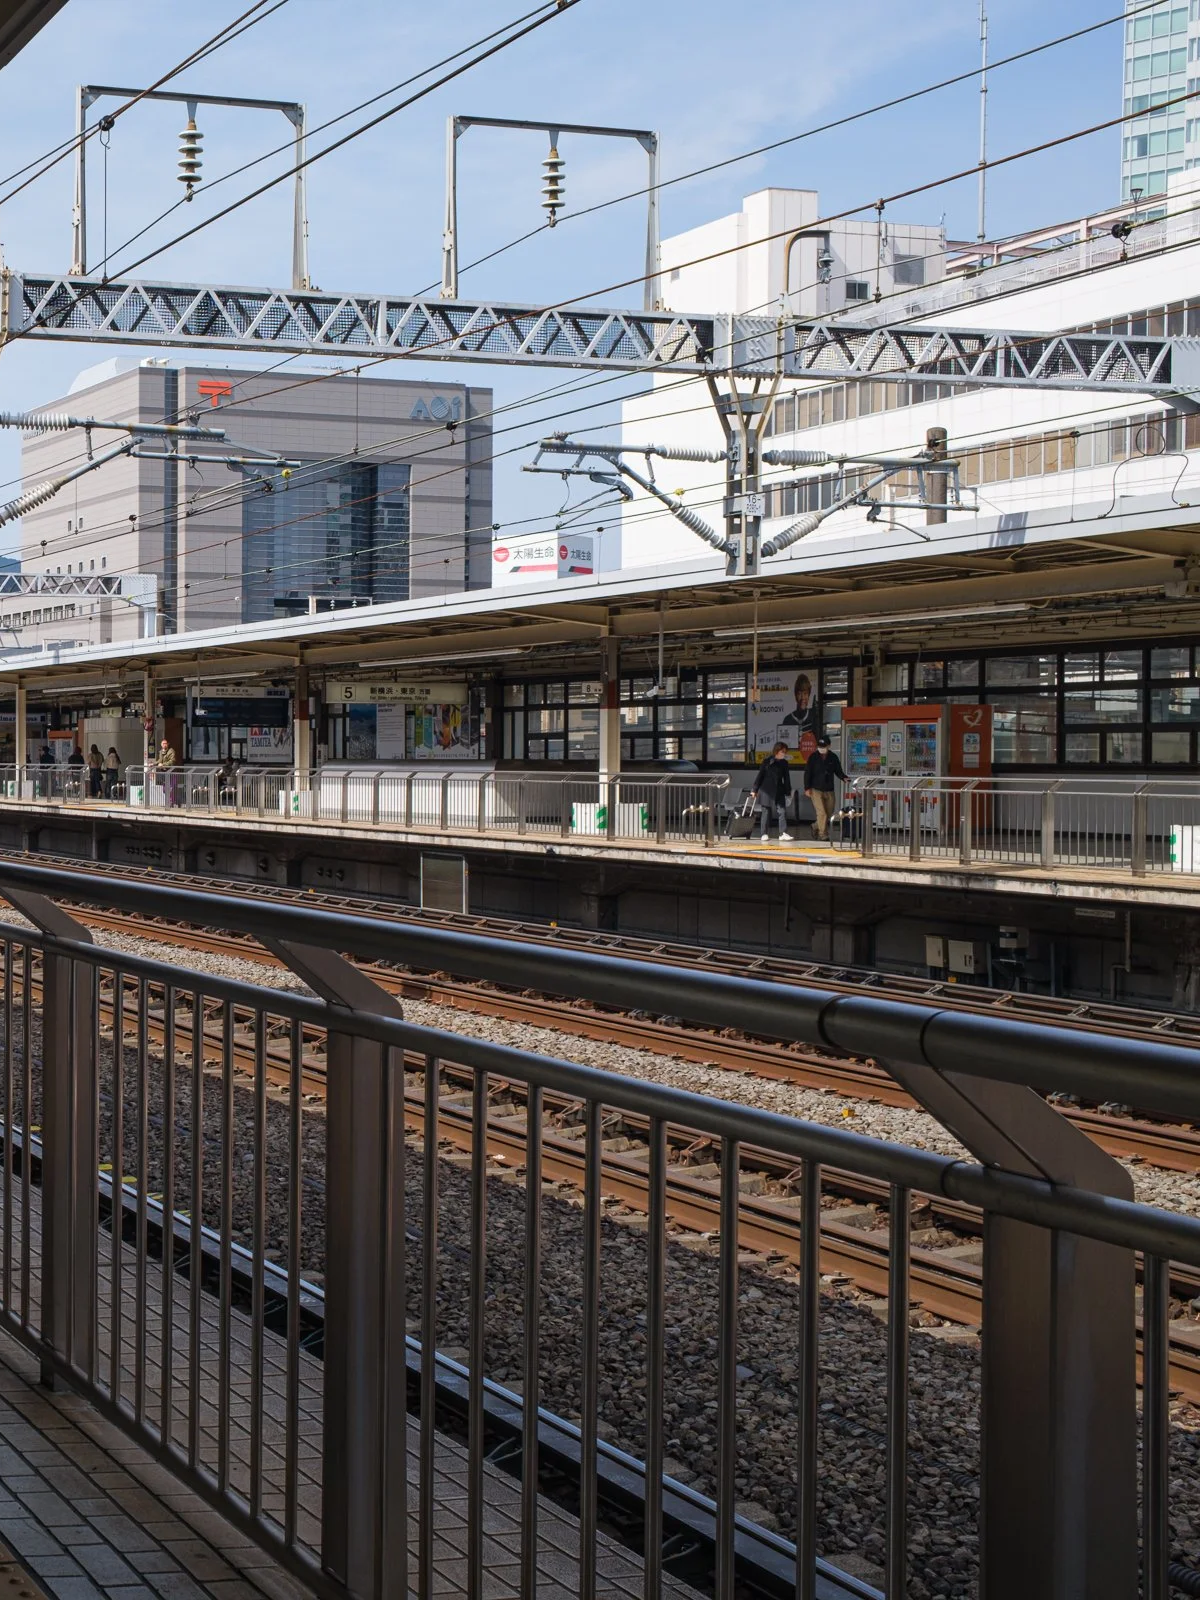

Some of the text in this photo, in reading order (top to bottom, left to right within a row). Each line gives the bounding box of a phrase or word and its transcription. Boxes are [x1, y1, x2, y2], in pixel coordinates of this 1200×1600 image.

[513, 545, 554, 560] 太陽生命
[571, 548, 592, 561] 太陽生命
[344, 686, 353, 699] 5
[251, 738, 271, 747] TAMIYA
